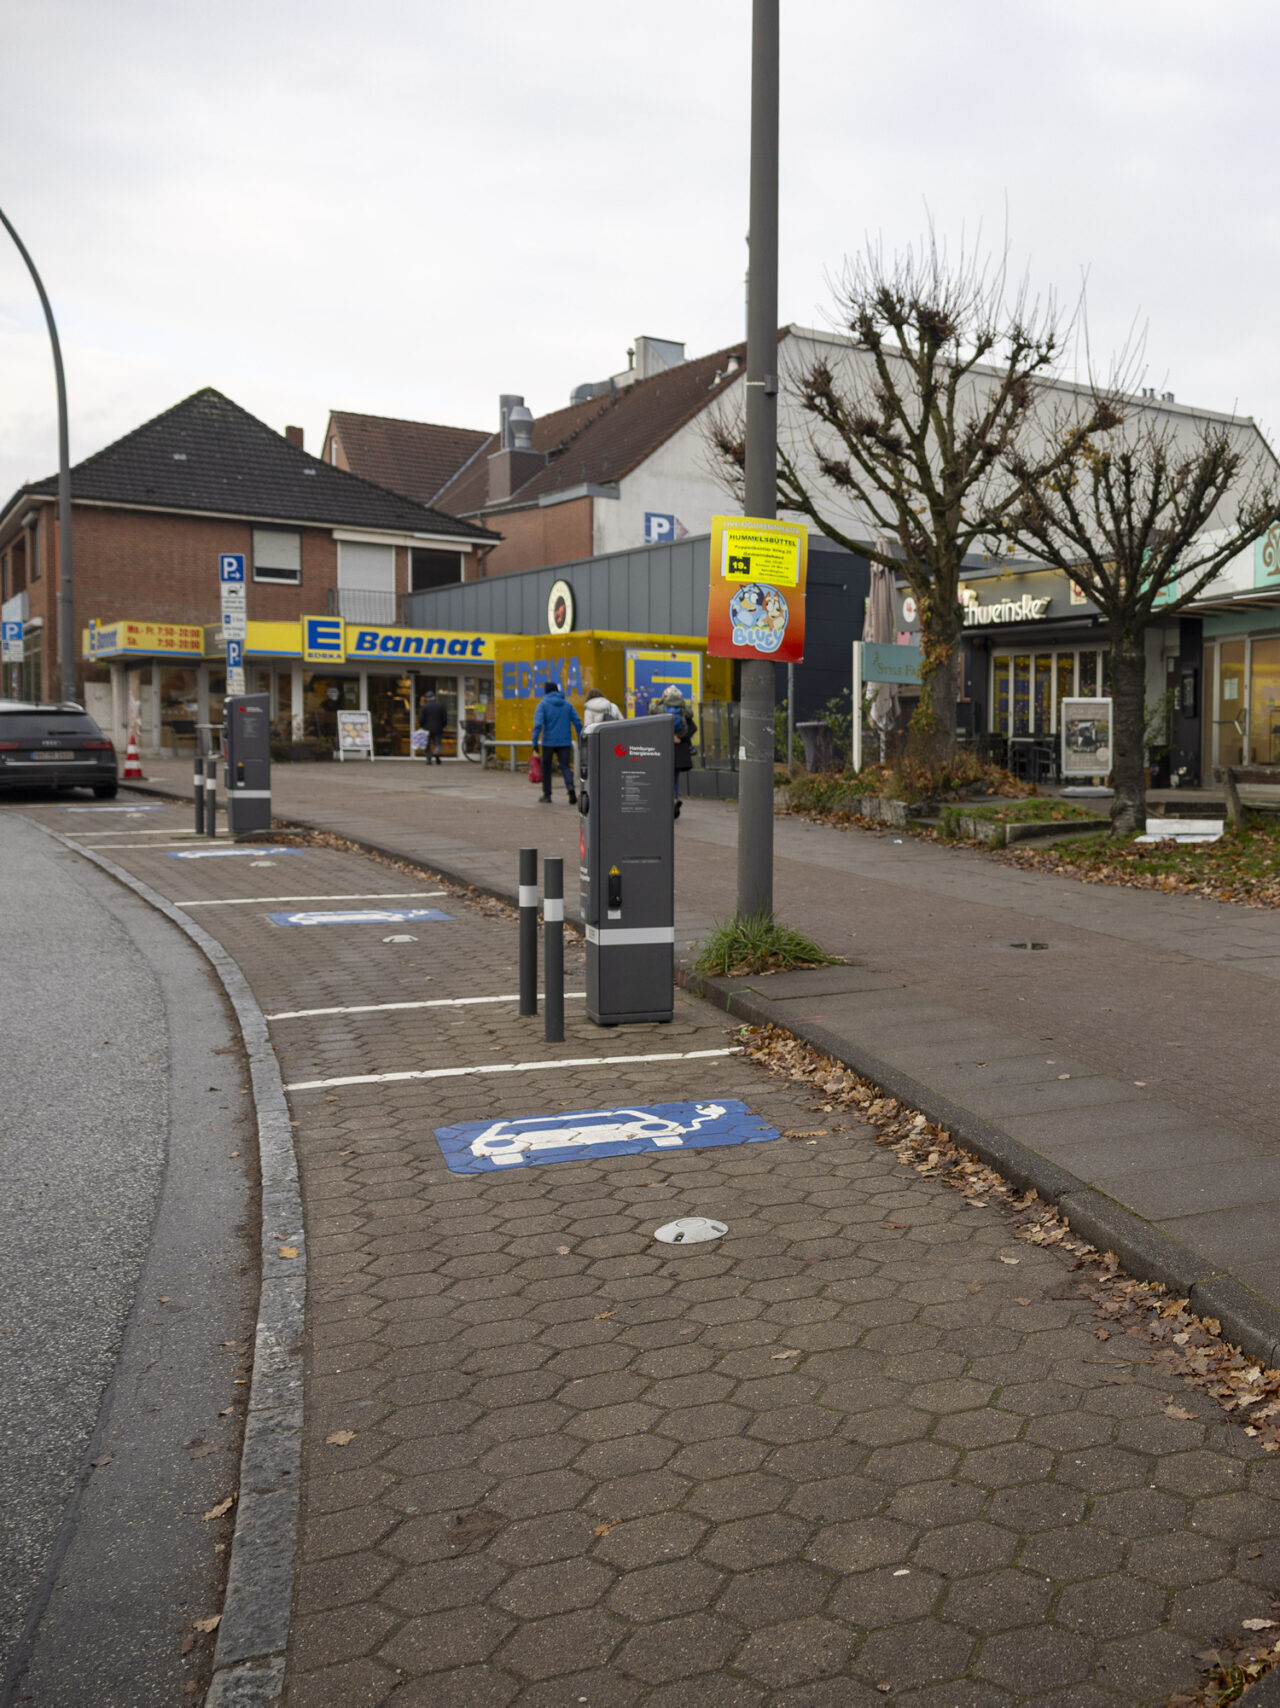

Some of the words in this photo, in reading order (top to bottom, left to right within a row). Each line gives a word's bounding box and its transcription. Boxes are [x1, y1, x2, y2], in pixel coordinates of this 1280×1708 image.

[651, 517, 670, 543] P
[729, 534, 797, 547] HUMMELSBÜTTEL
[223, 557, 238, 580] P
[732, 561, 747, 570] 19.
[963, 593, 1046, 627] hweinske
[6, 623, 18, 639] P
[733, 627, 784, 652] BLUEY
[229, 643, 240, 665] P
[355, 631, 485, 656] Bannat
[307, 652, 343, 660] EDEKA
[502, 656, 584, 699] EDEKA
